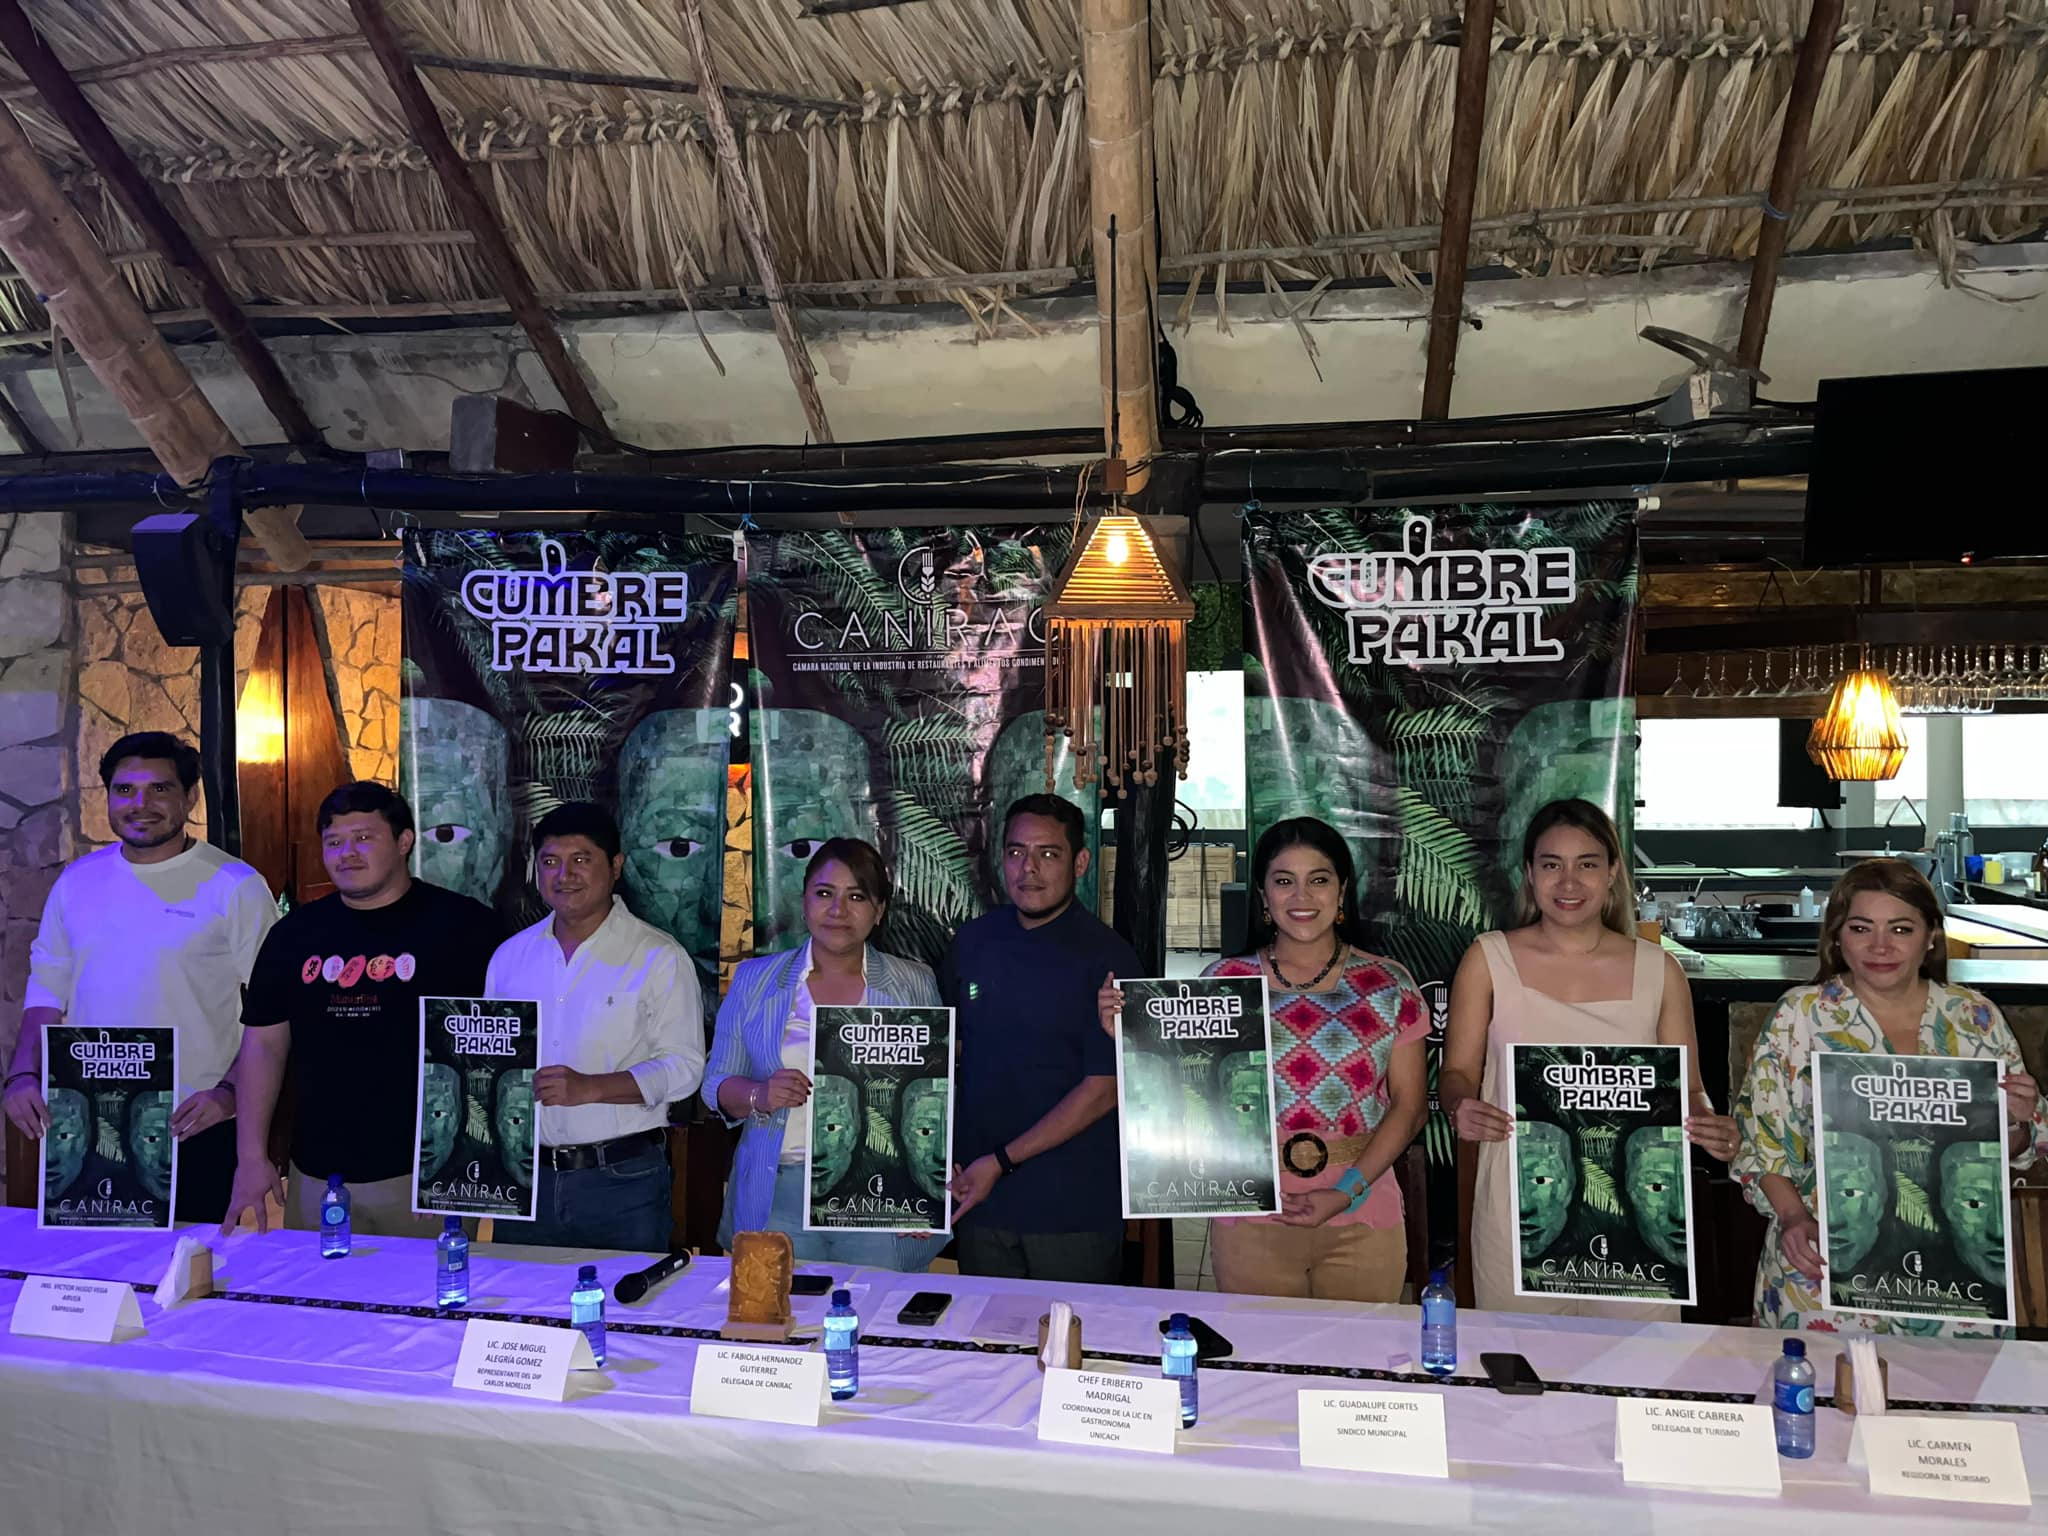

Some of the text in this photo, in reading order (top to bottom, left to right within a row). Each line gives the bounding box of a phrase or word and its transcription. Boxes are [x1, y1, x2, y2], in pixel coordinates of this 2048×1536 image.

[1307, 548, 1575, 607] CUMBRE
[461, 569, 688, 622] CUMBRE
[1345, 606, 1564, 664] PAKAL
[492, 621, 675, 673] PAKAL
[821, 661, 851, 671] NACIONAL
[853, 661, 861, 670] DE
[863, 661, 871, 670] LA
[873, 661, 906, 670] INDUSTRIA
[908, 660, 915, 669] DE
[1146, 995, 1242, 1018] CUMBRE
[444, 1015, 520, 1037] CUMBRE
[840, 1024, 929, 1045] CUMBRE
[1161, 1016, 1239, 1039] PAKAL
[70, 1042, 155, 1061] CUMBRE
[455, 1034, 516, 1056] PAKAL
[851, 1044, 924, 1065] PAKAL
[82, 1059, 150, 1079] PAKAL
[1544, 1065, 1655, 1088] CUMBRE
[1852, 1075, 1972, 1103] CUMBRE
[1559, 1087, 1650, 1111] PAKAL
[1869, 1098, 1967, 1125] PAKAL
[432, 1181, 518, 1201] CANIRAC
[1147, 1179, 1256, 1198] CANIRAC
[59, 1199, 153, 1215] CANIRAC
[827, 1197, 929, 1215] CANIRAC
[1541, 1259, 1666, 1282] CANIRAC
[1851, 1274, 1984, 1301] CANIRAC
[487, 1340, 547, 1353] LIC. JOSE MIGUEL
[485, 1353, 543, 1367] ALEGRÍA GOMEZ
[717, 1351, 803, 1365] LIC. FABIOLA HERNANDEZ
[477, 1367, 520, 1379] REPRESENTANTE
[740, 1365, 778, 1375] GUTIERREZ
[483, 1379, 531, 1390] CARLOS MORELOS
[721, 1377, 754, 1386] DELEGADA
[765, 1380, 793, 1390] CANIRAC
[1078, 1375, 1143, 1390] CHEF ERIBERTO
[1085, 1390, 1132, 1404] MADRIGAL
[1323, 1400, 1418, 1411] LIC. GUADALUPE CORTES
[1062, 1403, 1111, 1416] COORDINADOR
[1122, 1410, 1131, 1418] LA
[1132, 1411, 1142, 1420] LIC
[1355, 1414, 1388, 1423] JIMENEZ
[1645, 1407, 1744, 1422] LIC. ANGIE CABRERA
[1080, 1416, 1131, 1429] GASTRONOMIA
[1651, 1423, 1740, 1437] DELEGADA DE TURISMO
[1090, 1431, 1120, 1441] UNICACH
[1337, 1427, 1407, 1438] SINDICO MUNICIPAL
[1907, 1439, 1972, 1452] LIC. CARMEN
[1918, 1455, 1968, 1468] MORALES
[1942, 1473, 1953, 1482] DE
[1954, 1474, 1991, 1484] TURISMO
